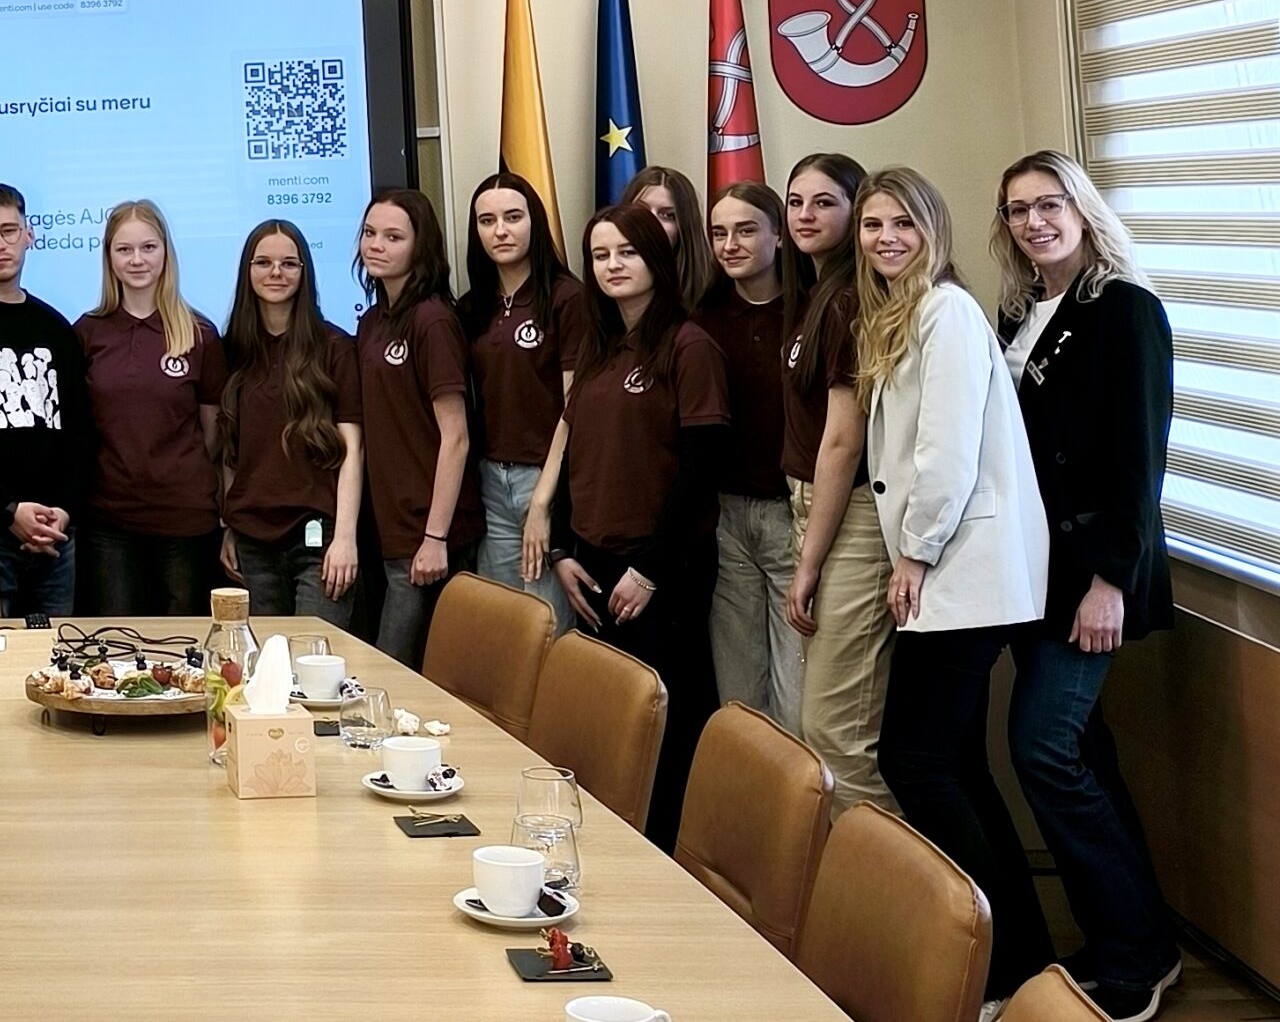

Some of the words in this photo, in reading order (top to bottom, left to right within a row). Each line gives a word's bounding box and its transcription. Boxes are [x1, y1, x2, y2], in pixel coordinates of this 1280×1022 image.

[37, 3, 53, 11] use
[53, 1, 75, 10] code
[80, 0, 102, 9] 8396
[102, 0, 123, 8] 3792
[75, 99, 97, 112] su
[102, 97, 151, 111] meru
[268, 176, 329, 186] menti.com
[267, 194, 299, 205] 8396
[301, 192, 332, 204] 3792
